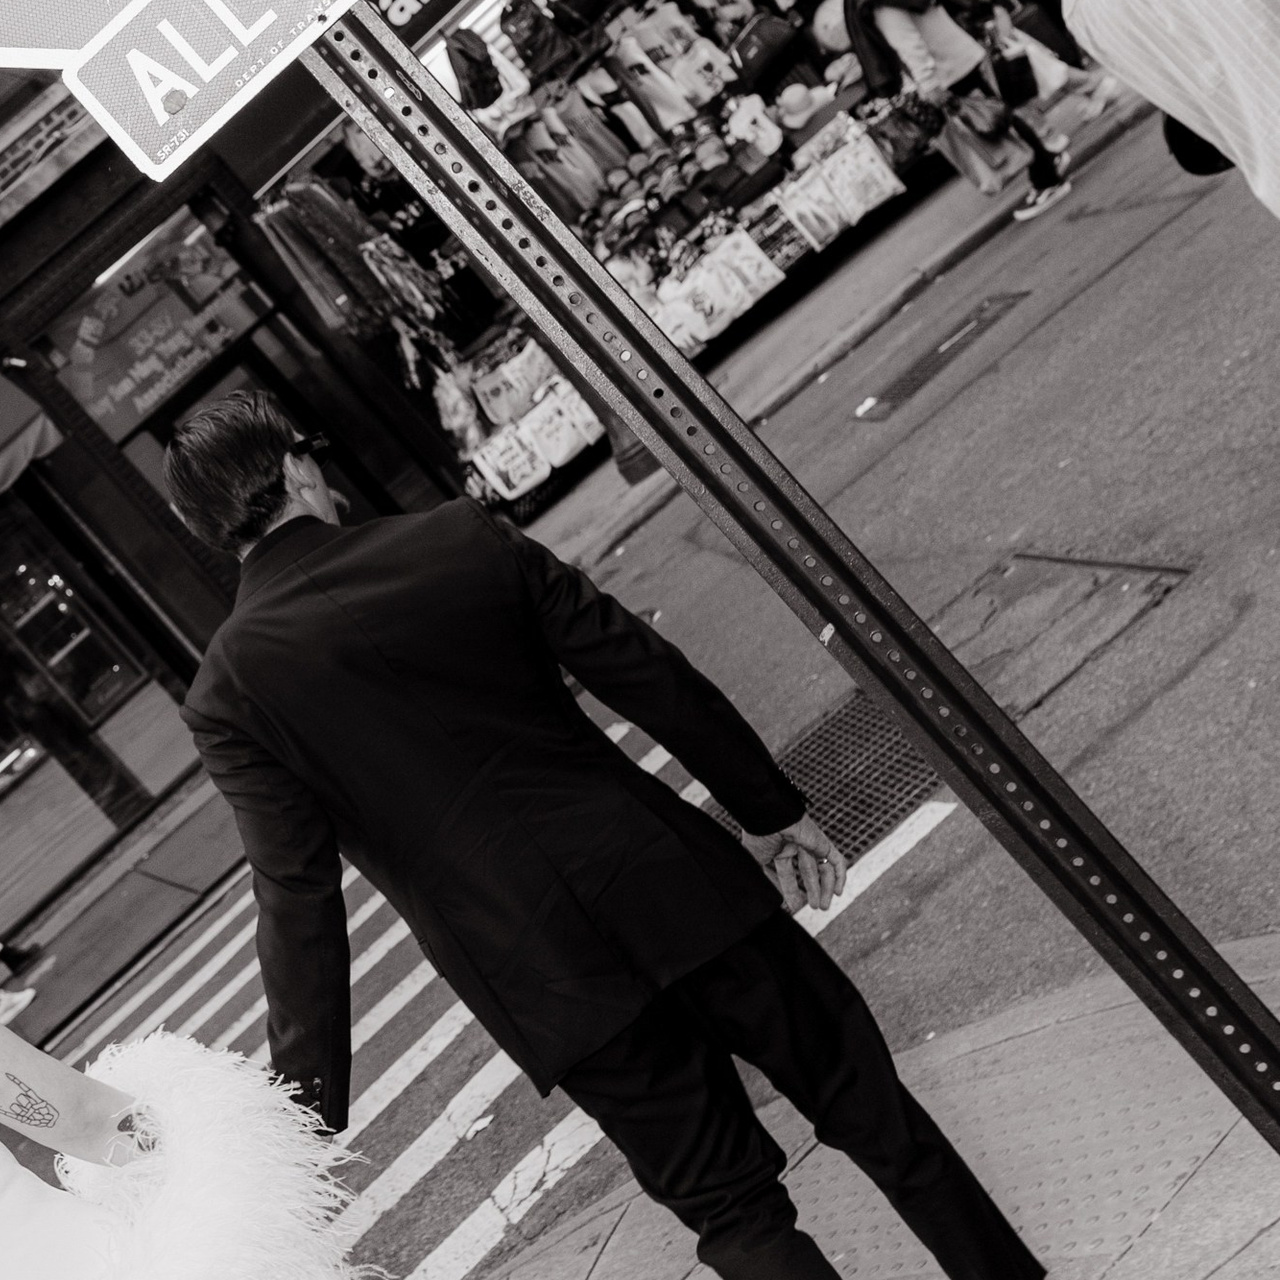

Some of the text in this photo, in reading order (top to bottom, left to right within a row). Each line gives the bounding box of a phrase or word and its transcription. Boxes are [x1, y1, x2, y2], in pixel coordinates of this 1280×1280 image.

[235, 55, 267, 88] DEPT
[270, 38, 286, 54] OF
[156, 128, 191, 162] SR-731
